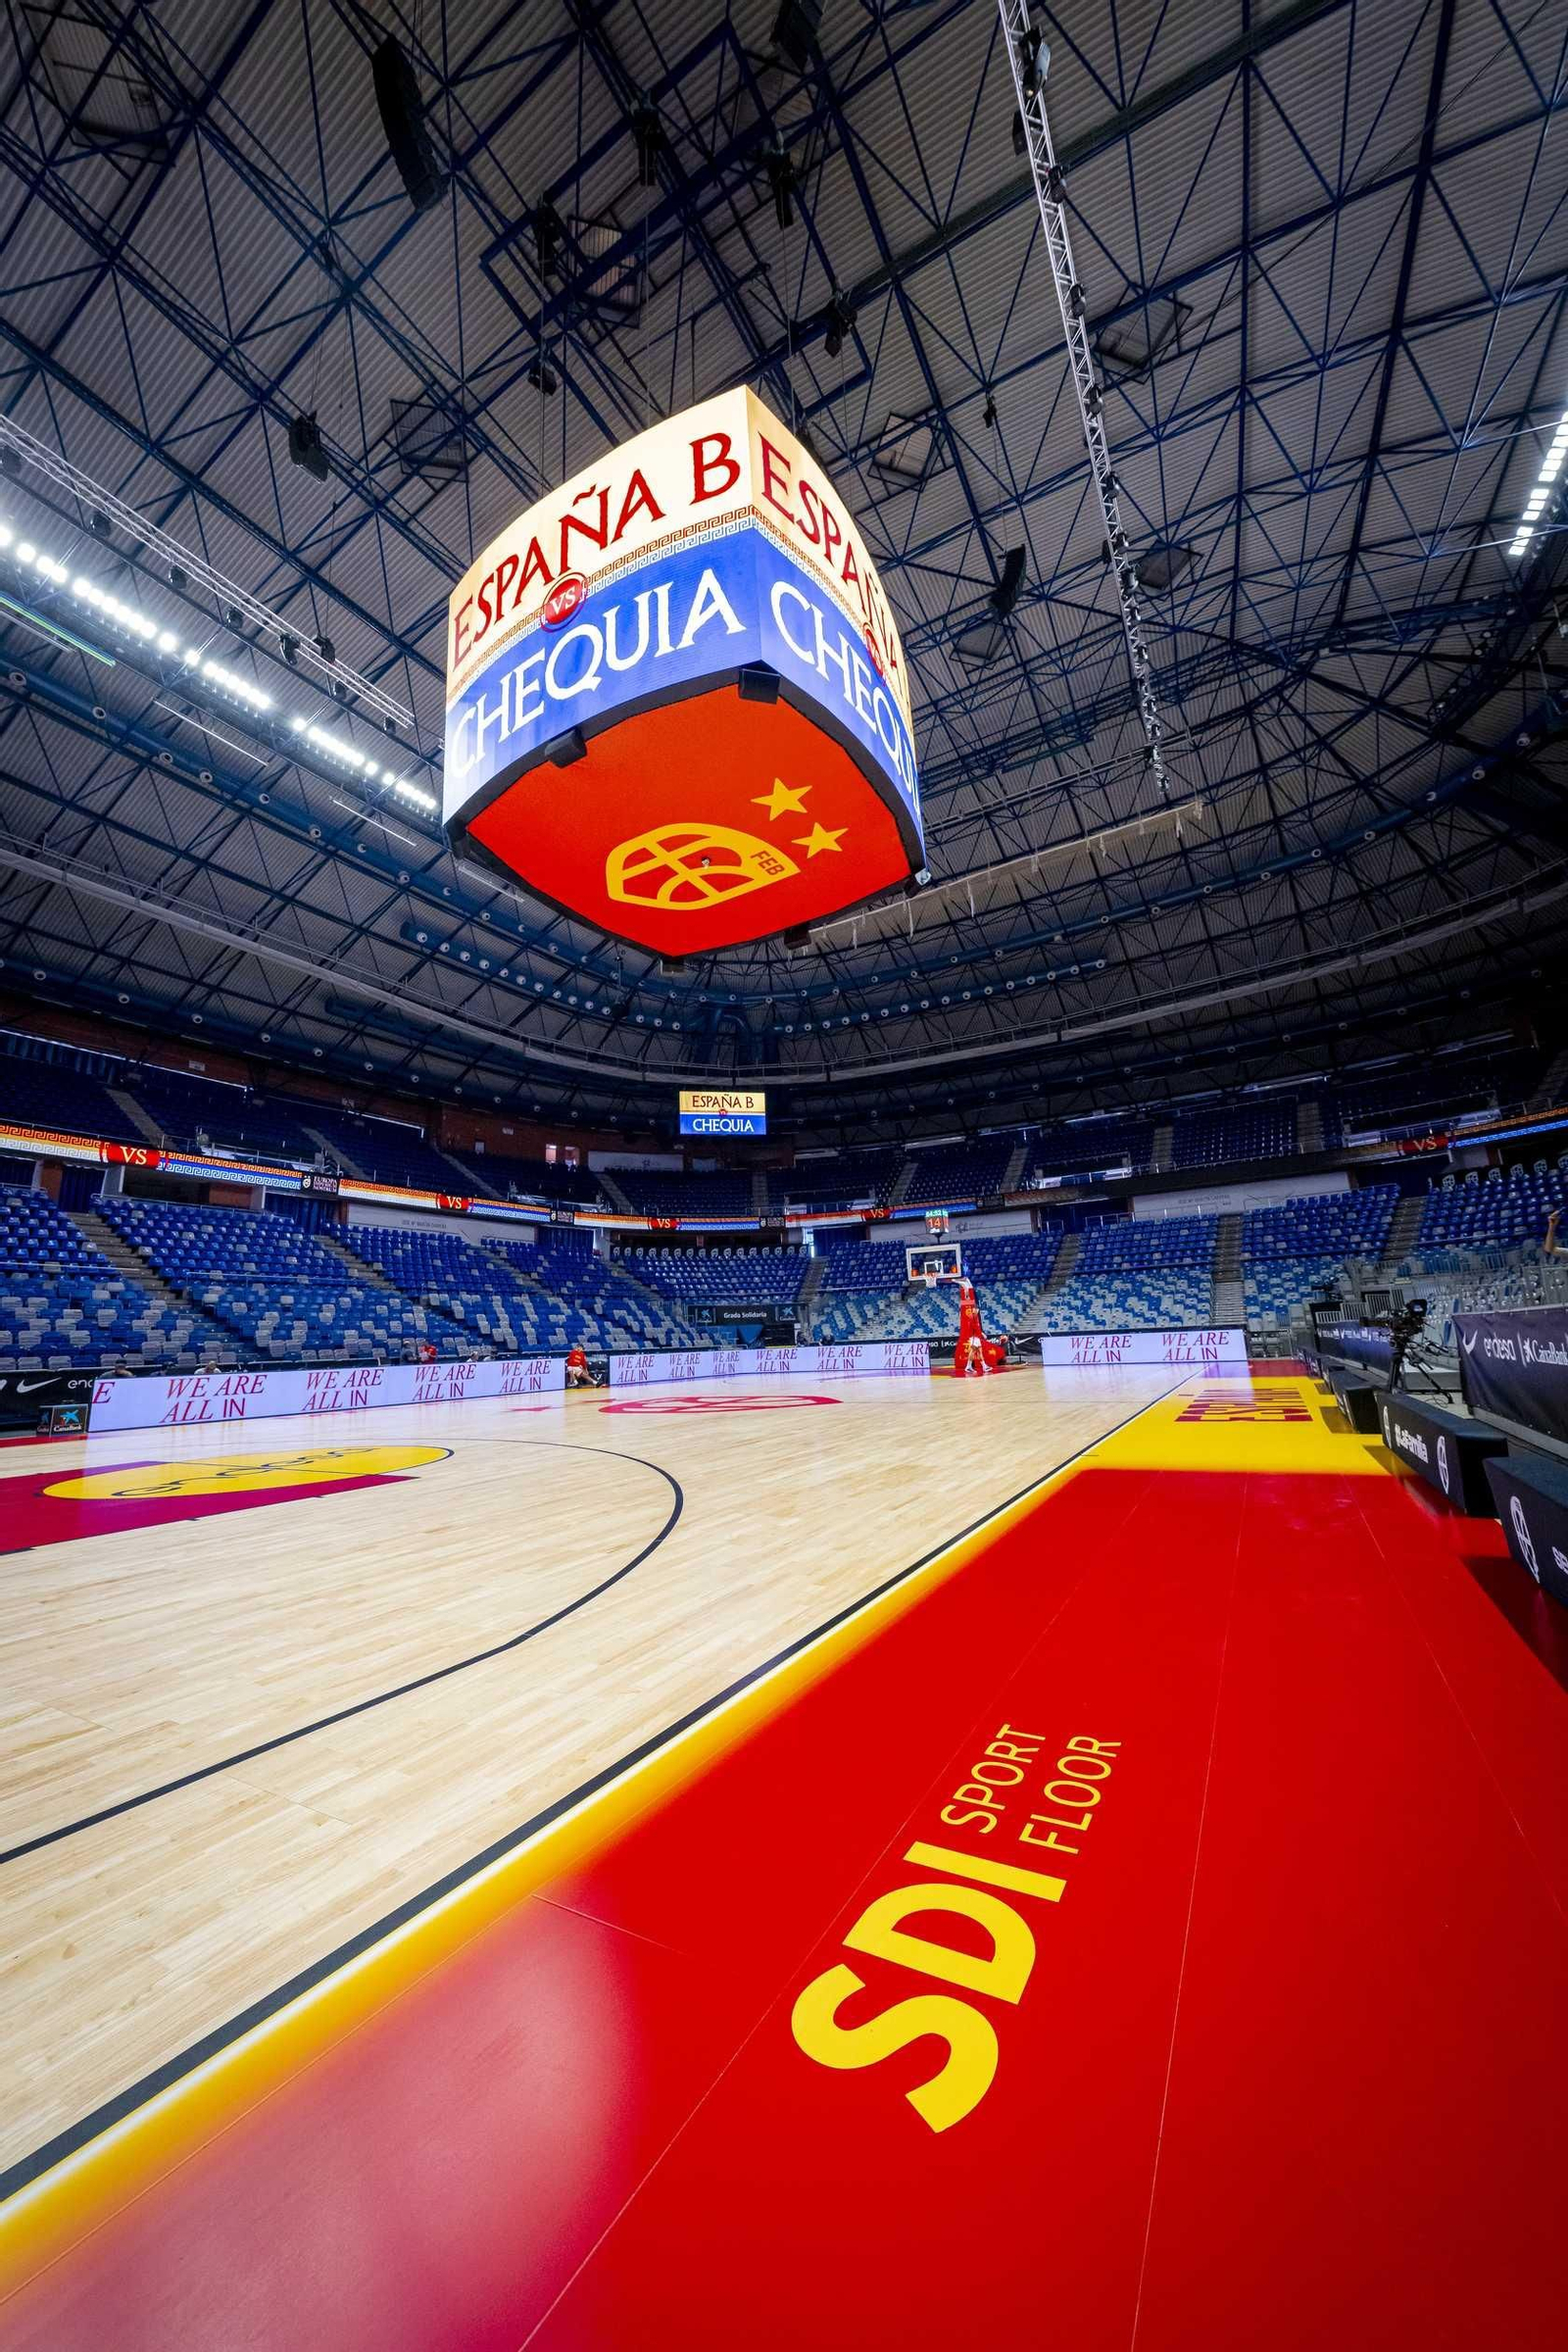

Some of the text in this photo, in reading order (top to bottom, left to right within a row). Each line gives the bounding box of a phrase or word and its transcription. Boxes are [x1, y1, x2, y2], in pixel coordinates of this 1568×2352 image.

[453, 432, 742, 672] ESPAÑA B
[758, 431, 899, 669] ESPAÑA
[550, 586, 575, 617] VS
[450, 568, 747, 779] CHEQUIA
[750, 851, 785, 875] FEB
[692, 1094, 755, 1109] ESPAÑA B
[693, 1118, 755, 1133] CHEQUIA
[1413, 1136, 1438, 1152] VS
[119, 1146, 148, 1165] VS
[447, 1196, 463, 1209] VS
[870, 1208, 885, 1219] VS
[657, 1218, 671, 1229] VS
[1070, 1335, 1133, 1349] WE ARE
[1162, 1331, 1230, 1348] WE ARE
[712, 1350, 740, 1363] WE ARE
[756, 1348, 799, 1361] WE ARE
[817, 1346, 863, 1358] WE ARE
[884, 1344, 905, 1355] WE
[1071, 1349, 1121, 1363] ALL IN
[1162, 1347, 1218, 1361] ALL IN
[617, 1355, 656, 1369] WE ARE
[669, 1352, 702, 1366] WE ARE
[756, 1360, 790, 1372] ALL IN
[816, 1359, 855, 1370] ALL IN
[884, 1356, 924, 1369] ALL IN
[415, 1364, 477, 1383] WE ARE
[500, 1359, 552, 1377] WE ARE
[669, 1365, 696, 1378] ALL IN
[712, 1362, 736, 1374] ALL IN
[306, 1368, 385, 1391] WE ARE
[616, 1370, 636, 1383] ALL
[639, 1369, 648, 1381] IN
[167, 1374, 268, 1399] WE ARE
[413, 1382, 465, 1401] ALL IN
[500, 1377, 542, 1394] ALL IN
[301, 1389, 368, 1411] ALL IN
[160, 1397, 245, 1423] ALL IN
[940, 1724, 1047, 1834] SPORT
[1018, 1736, 1122, 1854] FLOOR
[791, 1840, 1067, 2133] SDI
